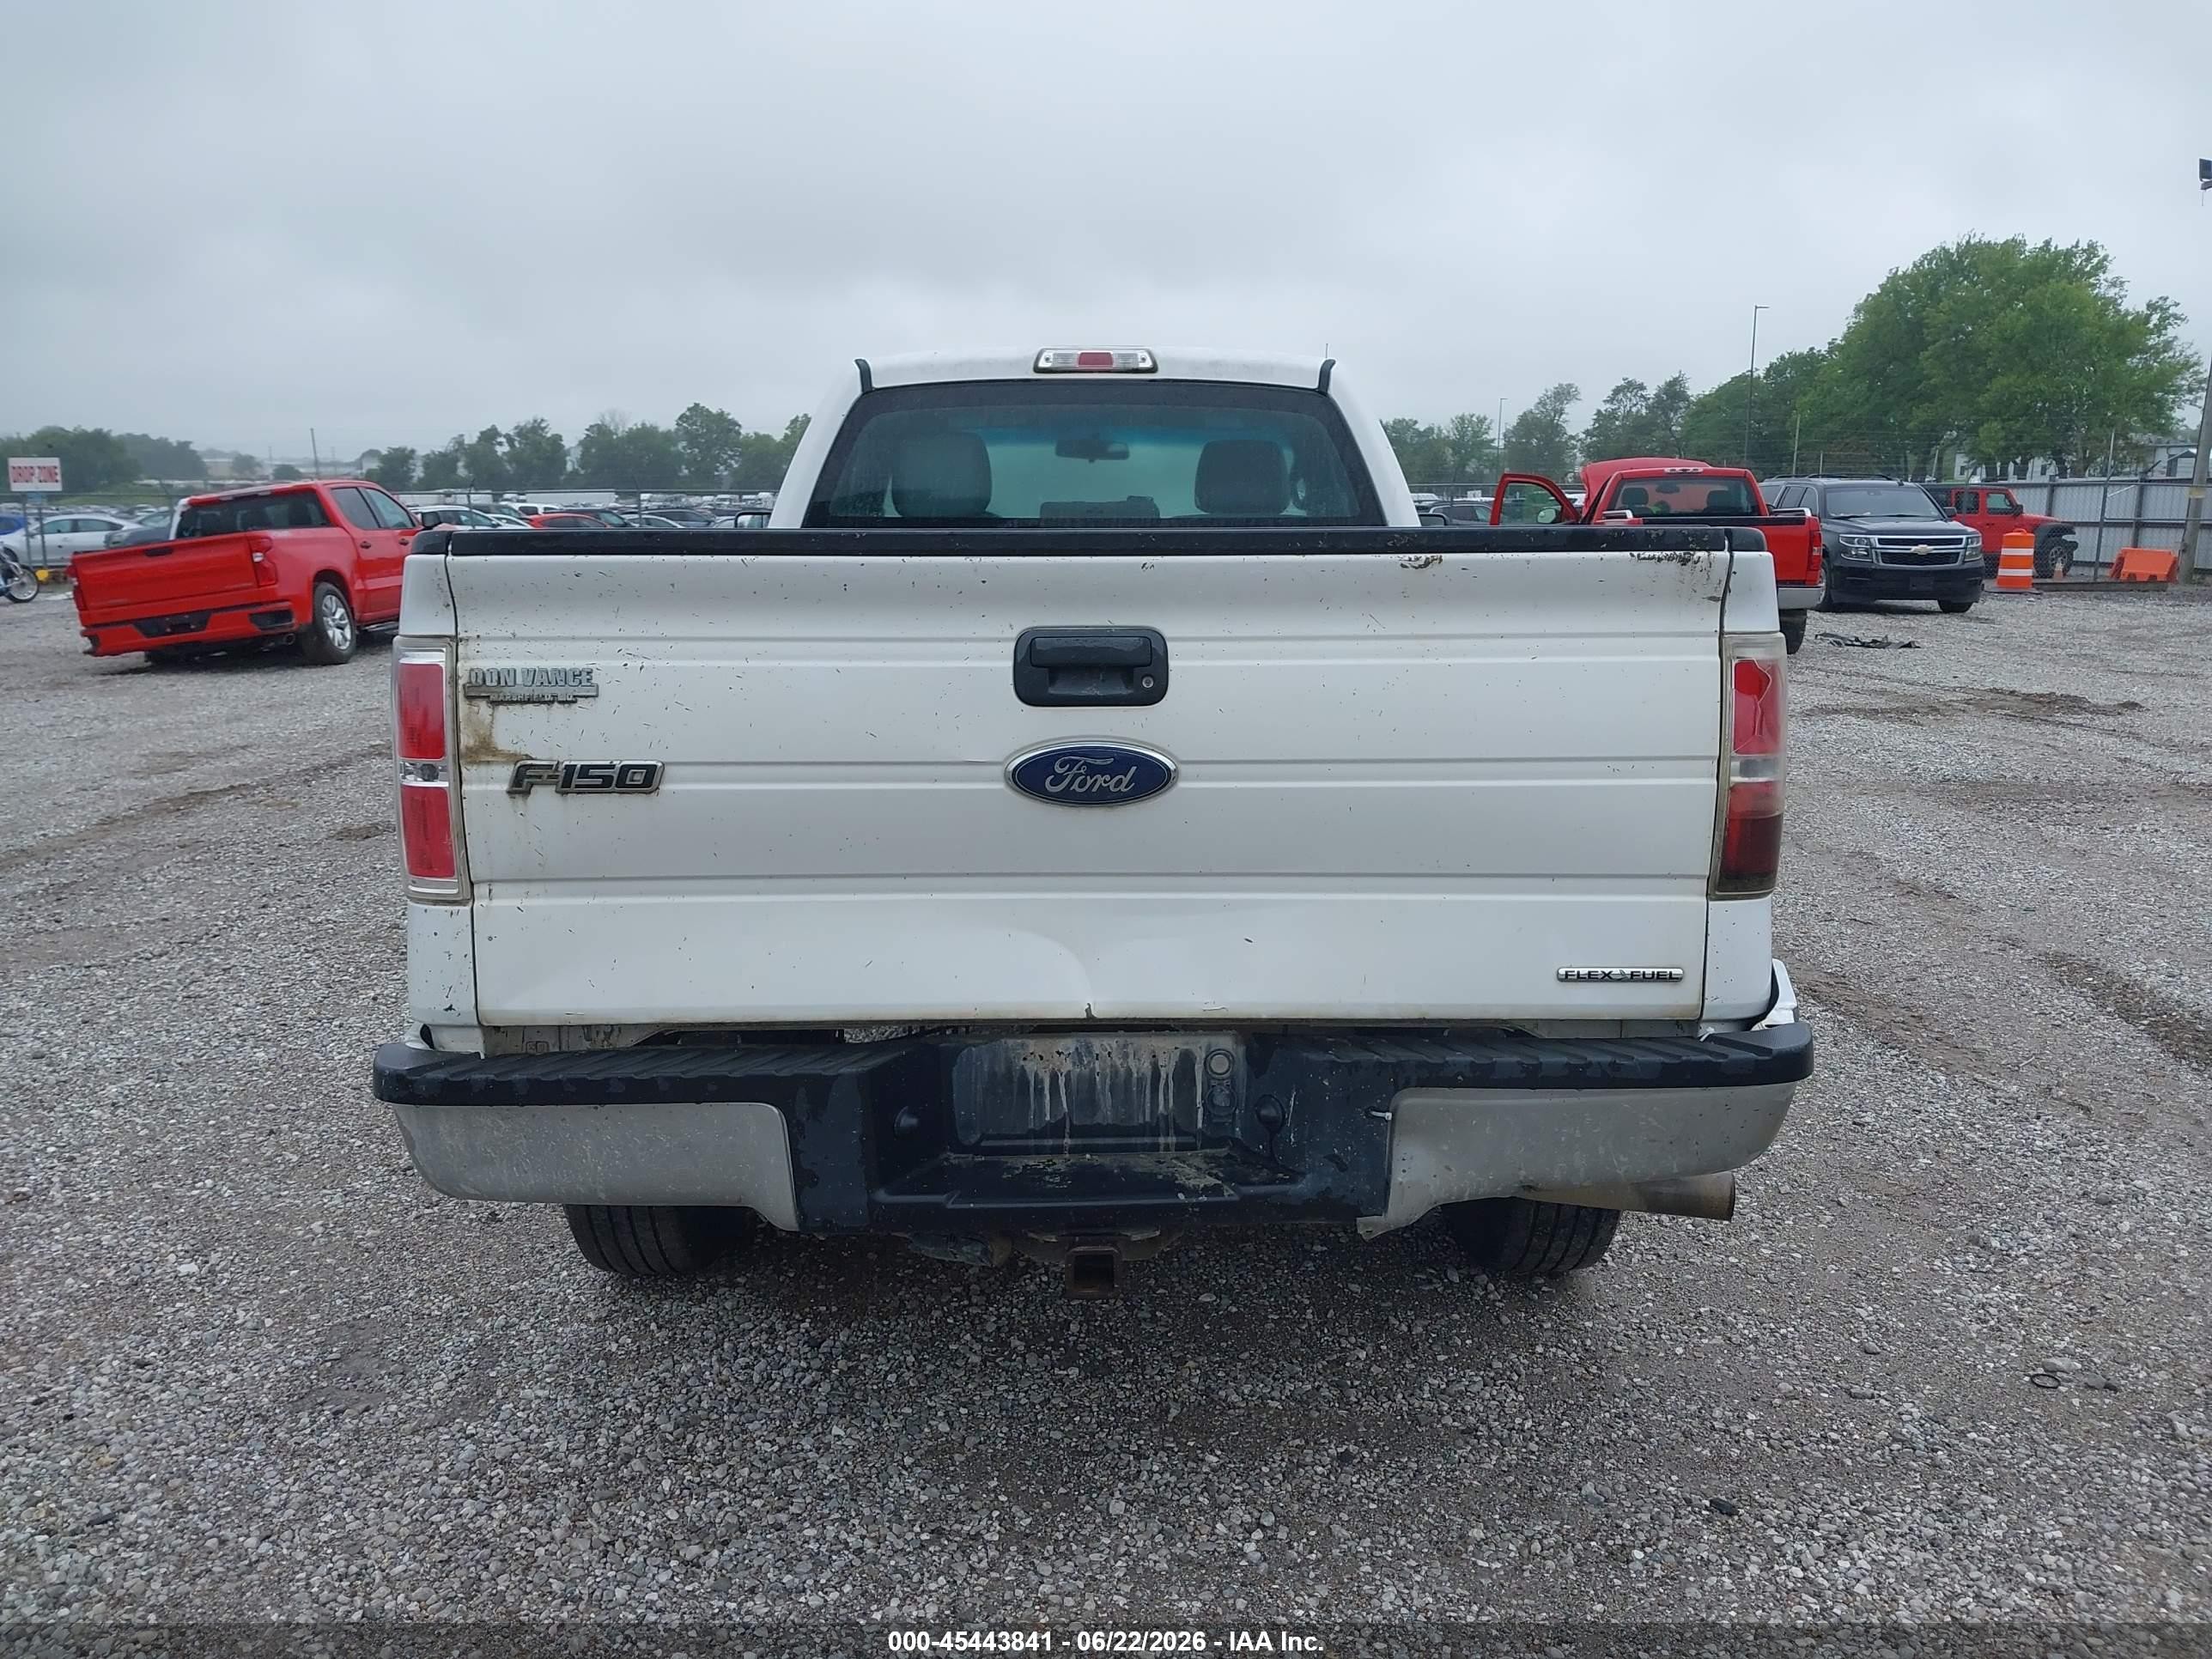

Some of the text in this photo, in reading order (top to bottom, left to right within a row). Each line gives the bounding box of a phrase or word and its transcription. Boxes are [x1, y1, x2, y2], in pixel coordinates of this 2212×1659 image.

[12, 465, 58, 483] DROP ZONE
[470, 667, 593, 687] DON VANCE
[507, 760, 665, 793] F-150
[1045, 756, 1138, 793] Ford
[1565, 970, 1680, 981] FLEX FUEL
